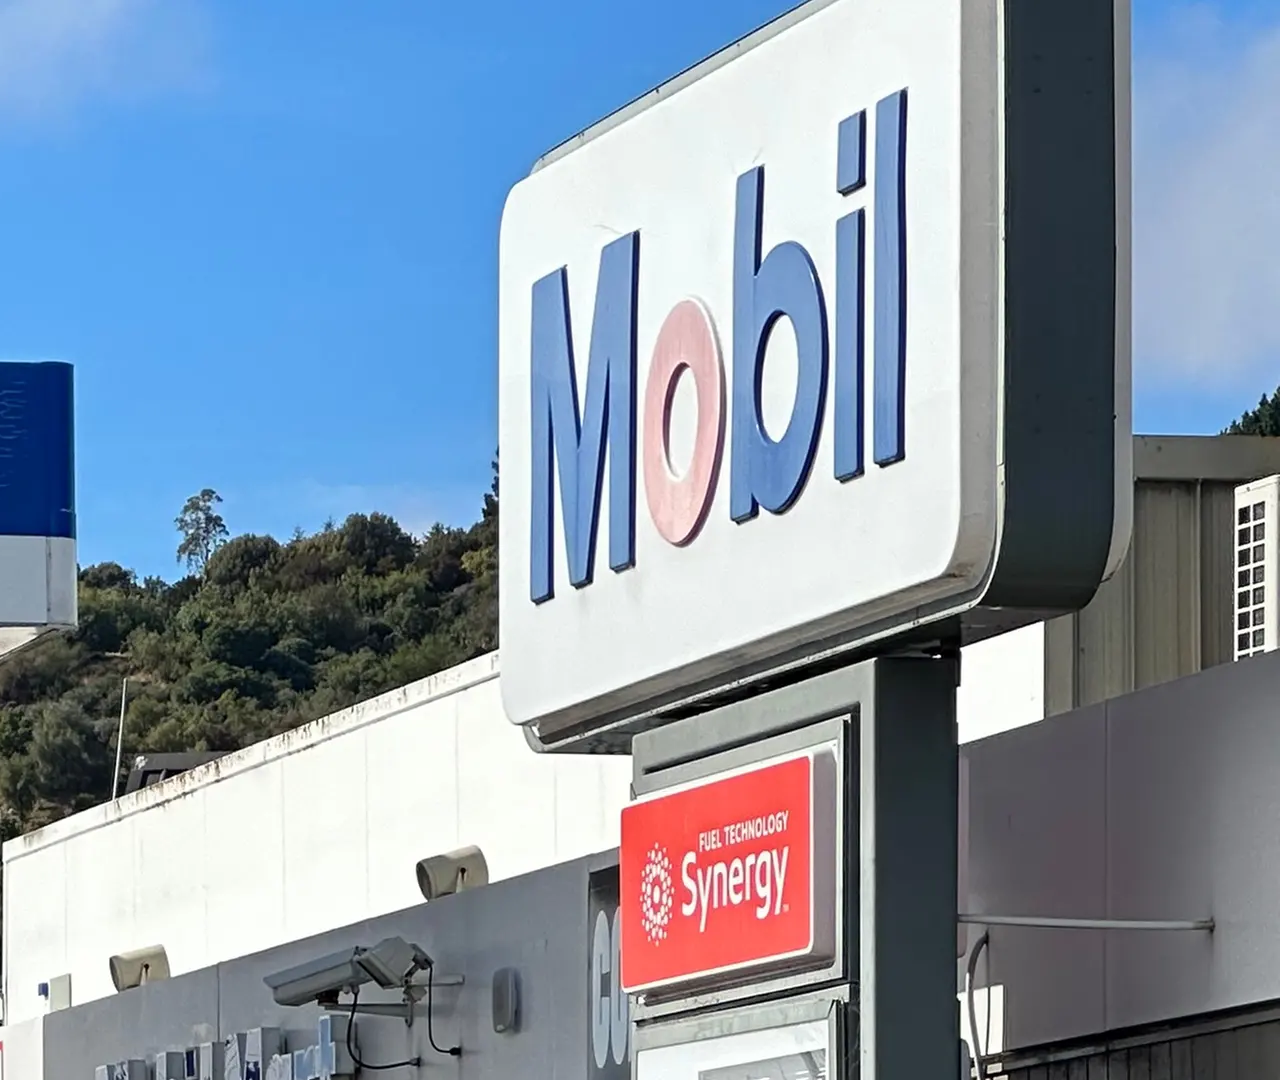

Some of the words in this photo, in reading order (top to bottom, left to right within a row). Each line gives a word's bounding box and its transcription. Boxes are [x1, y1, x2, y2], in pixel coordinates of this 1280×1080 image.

[530, 86, 909, 605] Mobil
[699, 830, 722, 852] FUEL
[724, 810, 789, 846] TECHNOLOGY
[681, 846, 790, 933] Synergy
